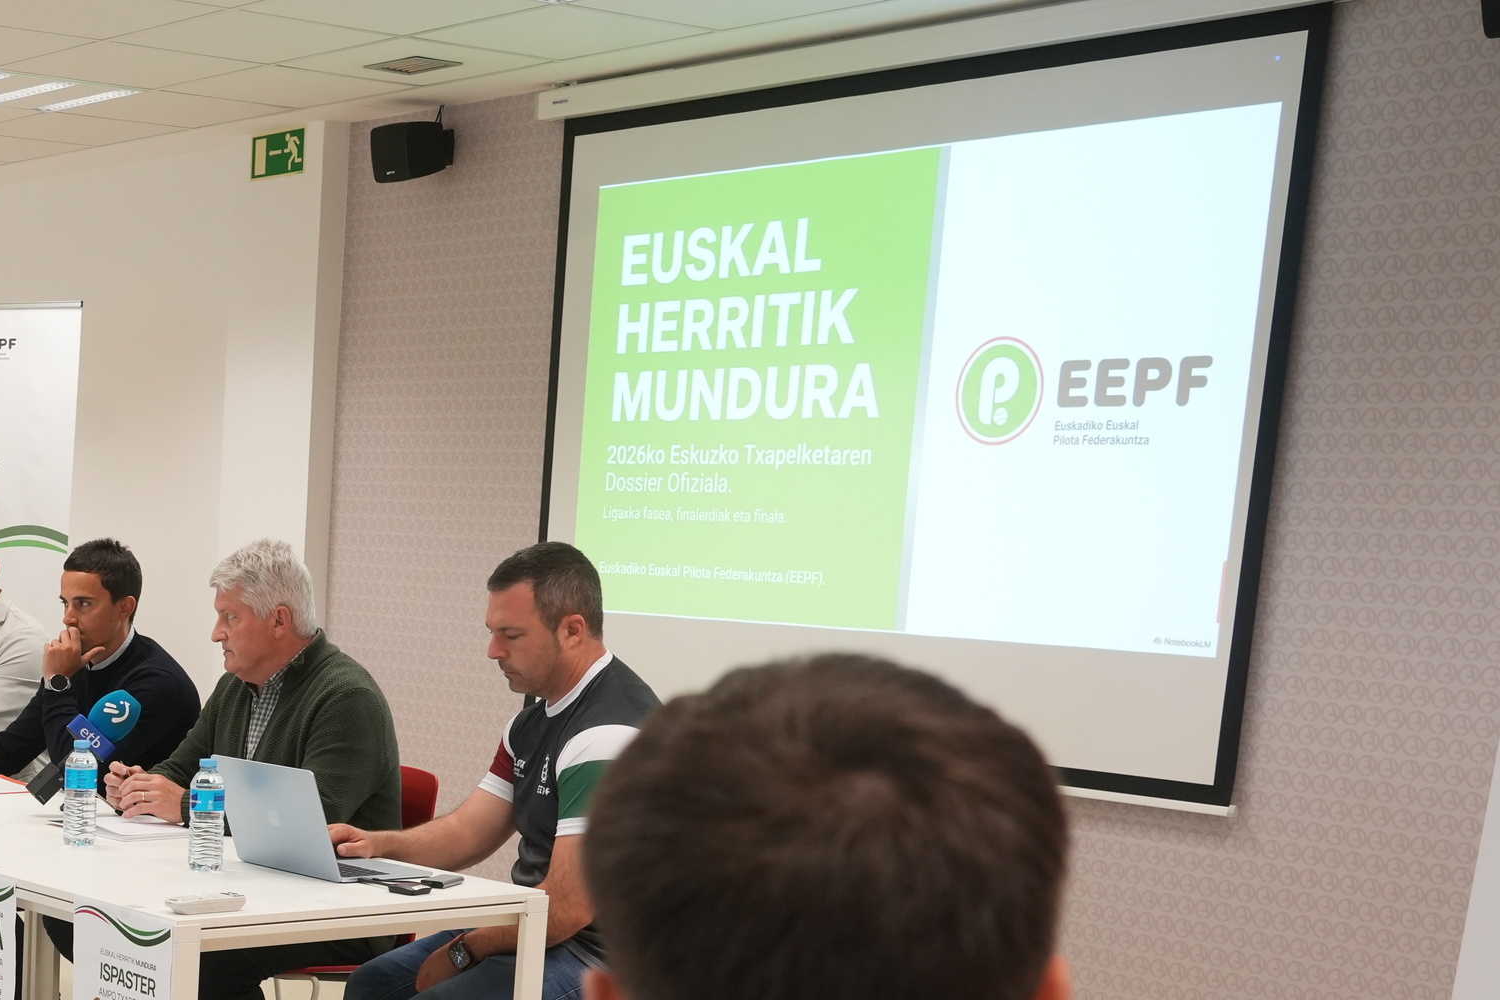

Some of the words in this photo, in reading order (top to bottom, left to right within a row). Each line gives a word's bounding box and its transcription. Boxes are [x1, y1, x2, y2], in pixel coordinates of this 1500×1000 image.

[621, 217, 821, 286] EUSKAL
[616, 288, 859, 354] HERRITIK
[611, 362, 879, 422] MUNDURA
[1057, 355, 1213, 407] EEPF
[1054, 420, 1103, 431] Euskadiko
[1106, 420, 1140, 431] Euskal
[1053, 435, 1080, 445] Pilota
[1082, 435, 1150, 445] Federakuntza
[606, 444, 665, 465] 2026ko
[669, 444, 739, 464] Eskuzko
[744, 443, 872, 470] Txapelketaren
[605, 472, 662, 493] Dossier
[667, 472, 731, 493] Ofiziala.
[602, 506, 641, 522] Ligaxka
[643, 507, 673, 523] fasea,
[676, 507, 731, 522] finalerdiak
[733, 510, 750, 522] eta
[753, 508, 786, 524] finala.
[599, 561, 646, 575] Euskadiko
[648, 563, 680, 577] Euskal
[683, 565, 711, 579] Pilota
[714, 567, 783, 583] Federakuntza
[785, 569, 825, 588] (EEPF).
[1164, 637, 1211, 648] NotebookLM
[80, 728, 102, 749] etb
[100, 947, 116, 959] EUSKAL
[116, 952, 136, 964] HERRITIK
[135, 959, 157, 971] MUNDURA
[99, 961, 156, 998] ISPASTER
[98, 987, 117, 1000] AMPO
